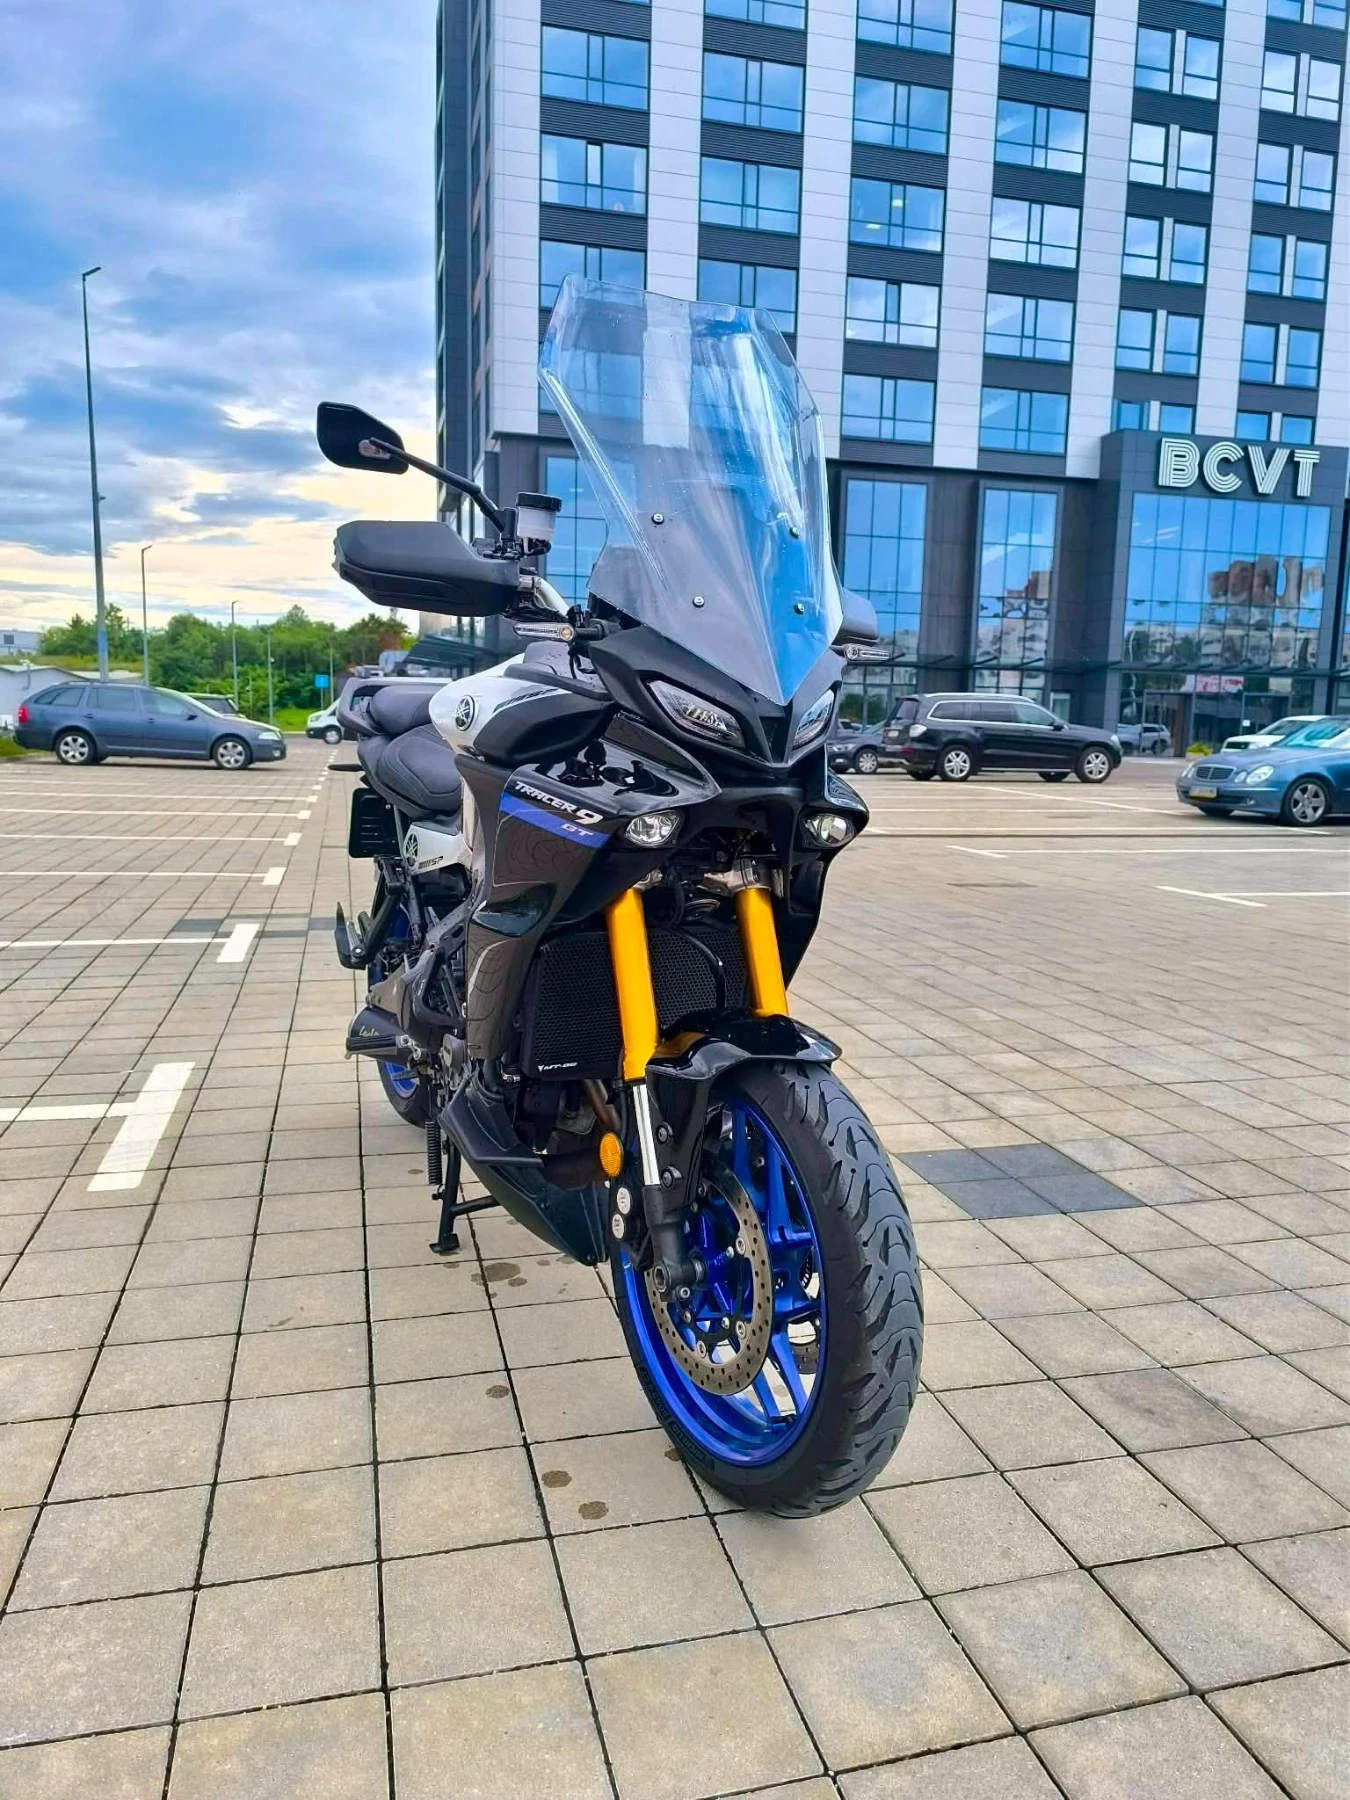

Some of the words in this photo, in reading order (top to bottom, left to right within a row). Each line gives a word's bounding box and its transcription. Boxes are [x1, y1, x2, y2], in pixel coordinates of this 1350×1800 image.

[1158, 438, 1321, 497] BCVT
[515, 781, 577, 814] TRACER
[574, 808, 604, 825] 9
[561, 823, 594, 836] GT
